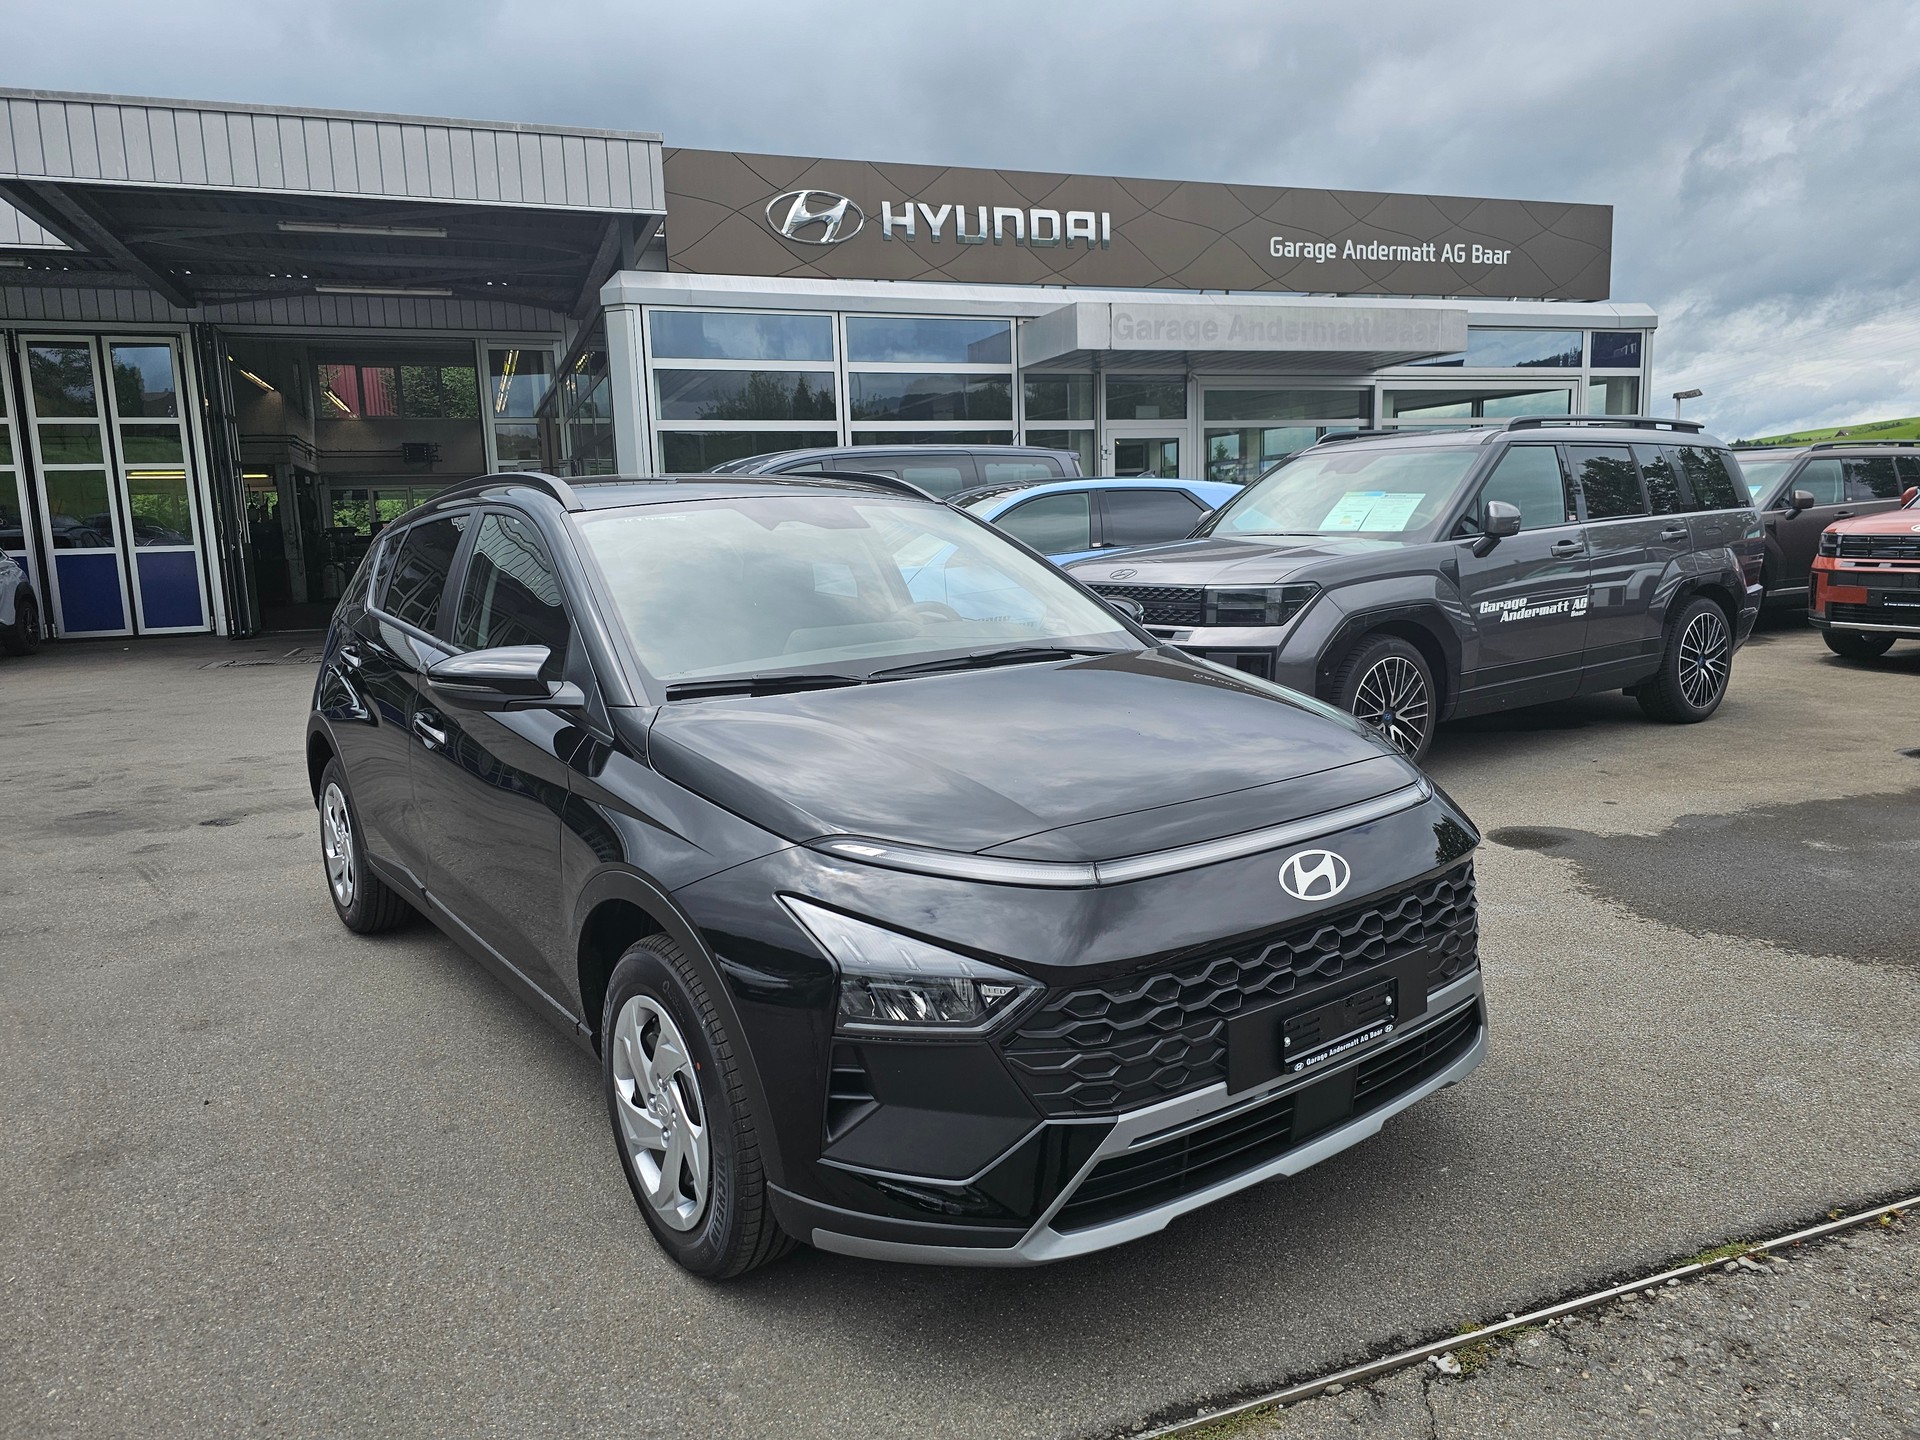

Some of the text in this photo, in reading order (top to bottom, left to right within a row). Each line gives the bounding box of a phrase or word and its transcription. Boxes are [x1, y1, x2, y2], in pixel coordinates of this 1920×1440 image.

[881, 201, 1111, 250] HYUNDAI
[1269, 236, 1511, 265] Garage Andermatt AG Baar
[1112, 312, 1219, 346] Garage
[1480, 598, 1527, 613] Garage
[1500, 597, 1588, 622] Andermatt AG
[1306, 1028, 1383, 1066] Garage Andermatt AG Baar
